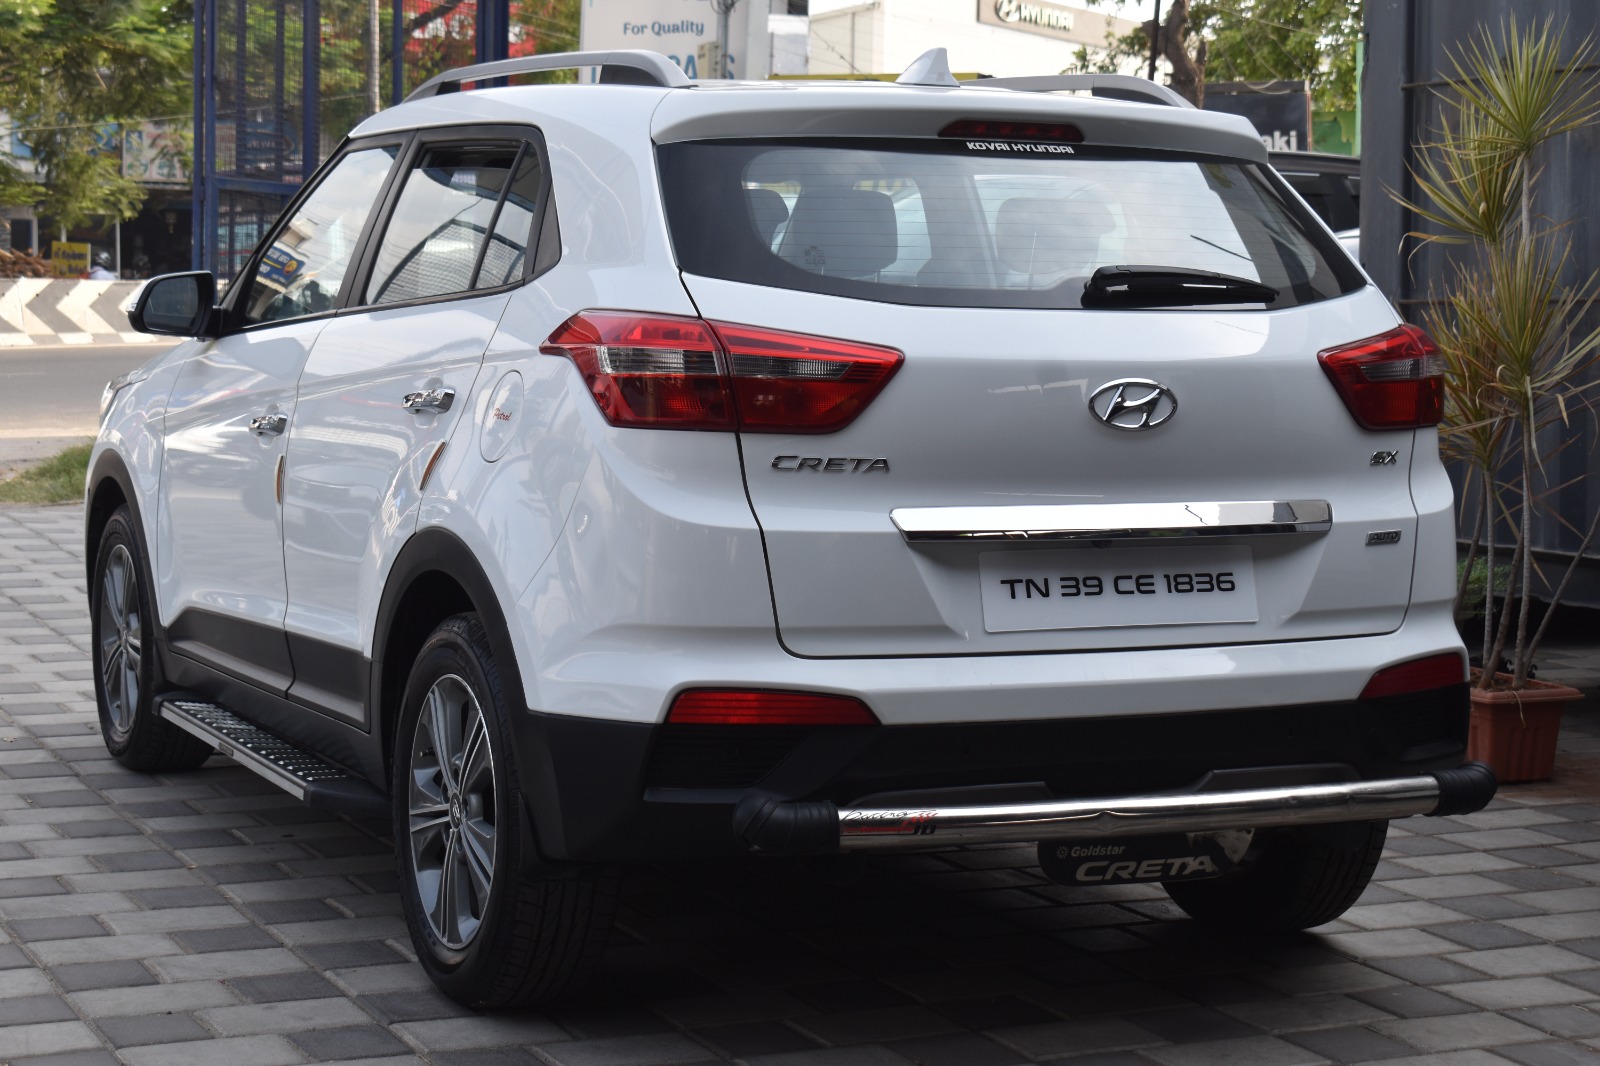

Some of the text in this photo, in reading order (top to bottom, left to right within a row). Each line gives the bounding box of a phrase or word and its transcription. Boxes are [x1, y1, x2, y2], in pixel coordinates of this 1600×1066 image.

[1019, 3, 1074, 32] HYUNDAI
[623, 20, 705, 36] For Quality
[966, 141, 1075, 154] KOVAI HYUNDAI
[771, 455, 890, 472] CRETA
[1370, 450, 1399, 466] SX
[1371, 532, 1399, 542] AUTO
[1000, 572, 1236, 599] TN 39 CE 1836
[1070, 844, 1126, 857] Goldstar
[1076, 855, 1216, 882] CRETA
